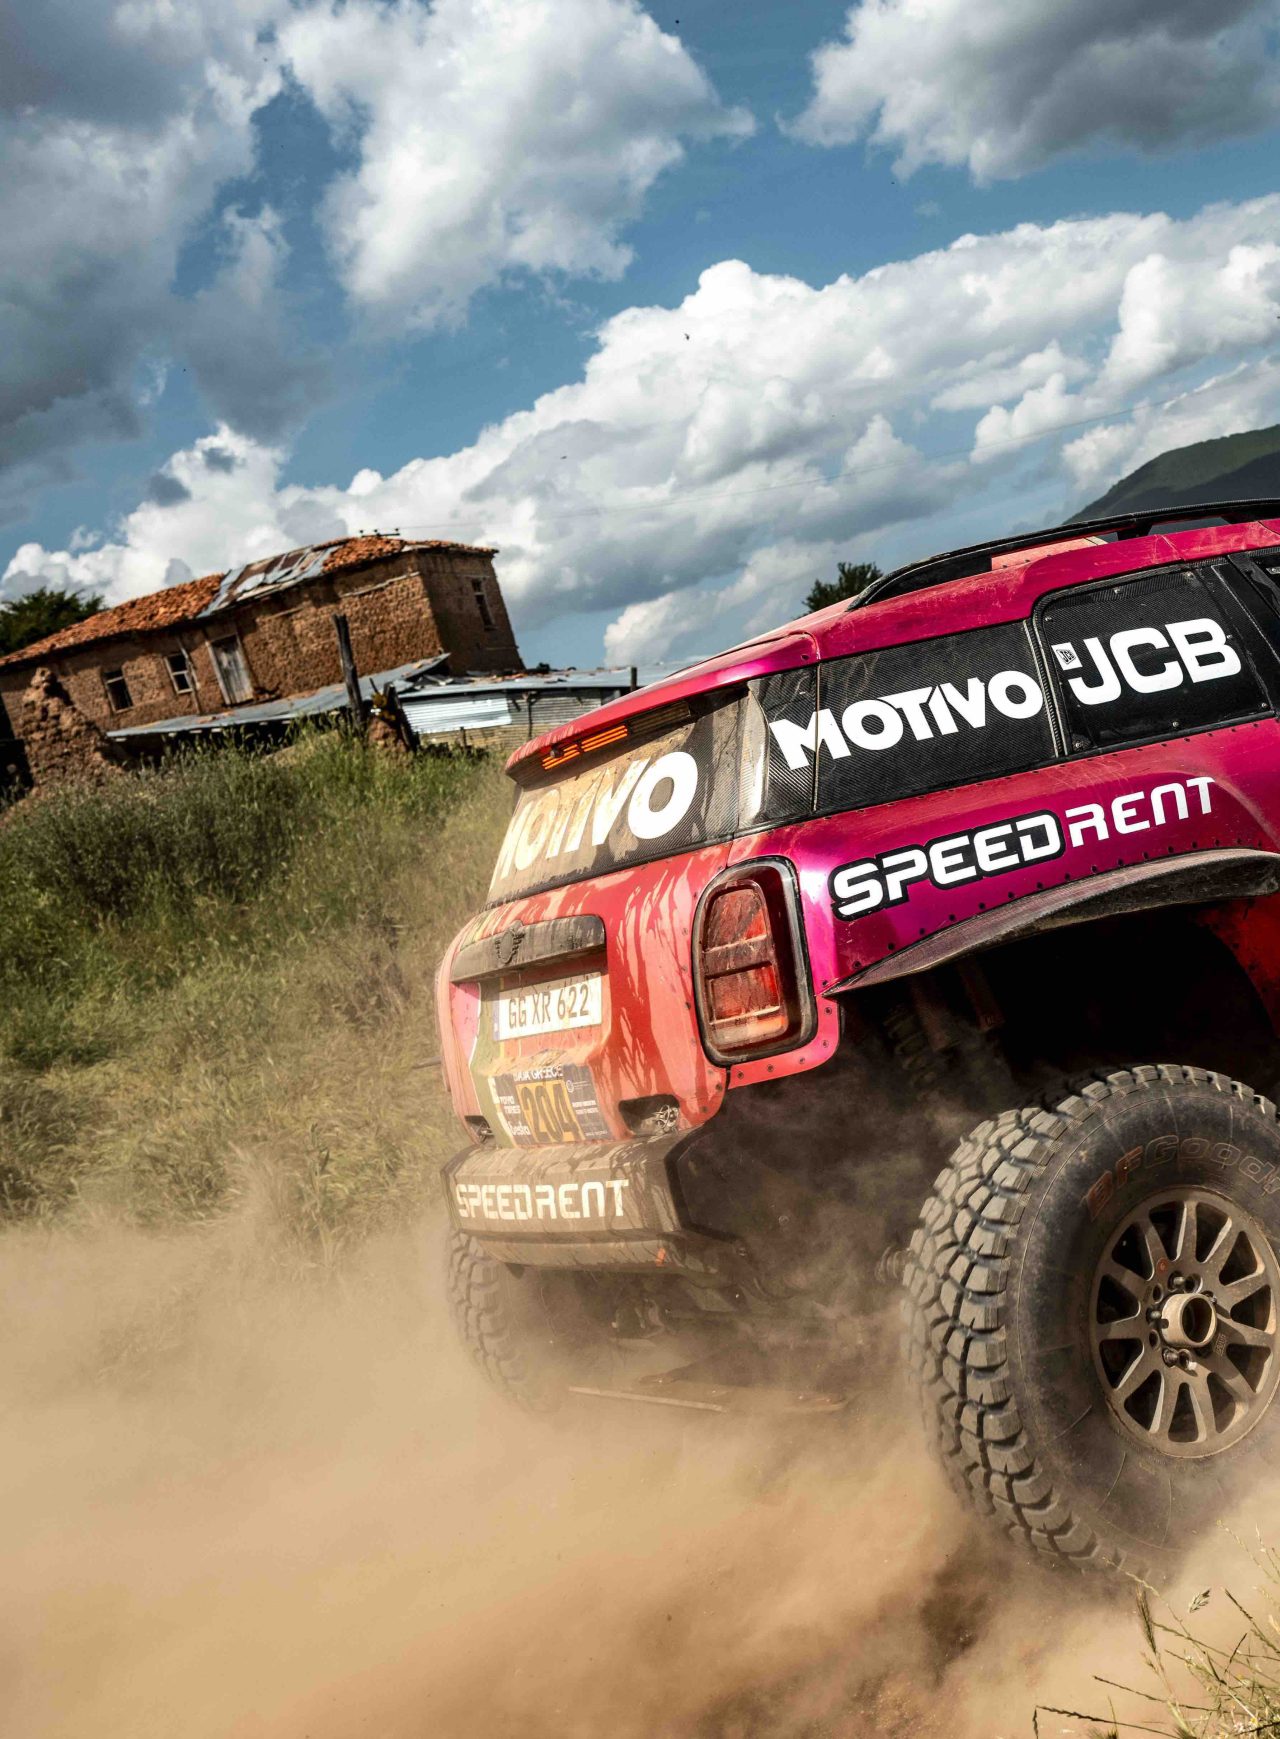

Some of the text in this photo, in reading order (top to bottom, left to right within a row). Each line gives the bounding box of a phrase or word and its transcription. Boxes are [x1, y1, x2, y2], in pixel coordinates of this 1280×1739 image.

[1067, 617, 1242, 705] JCB
[769, 670, 1044, 770] MOTIVO
[508, 984, 590, 1029] GG XR 622
[521, 1083, 580, 1142] 204
